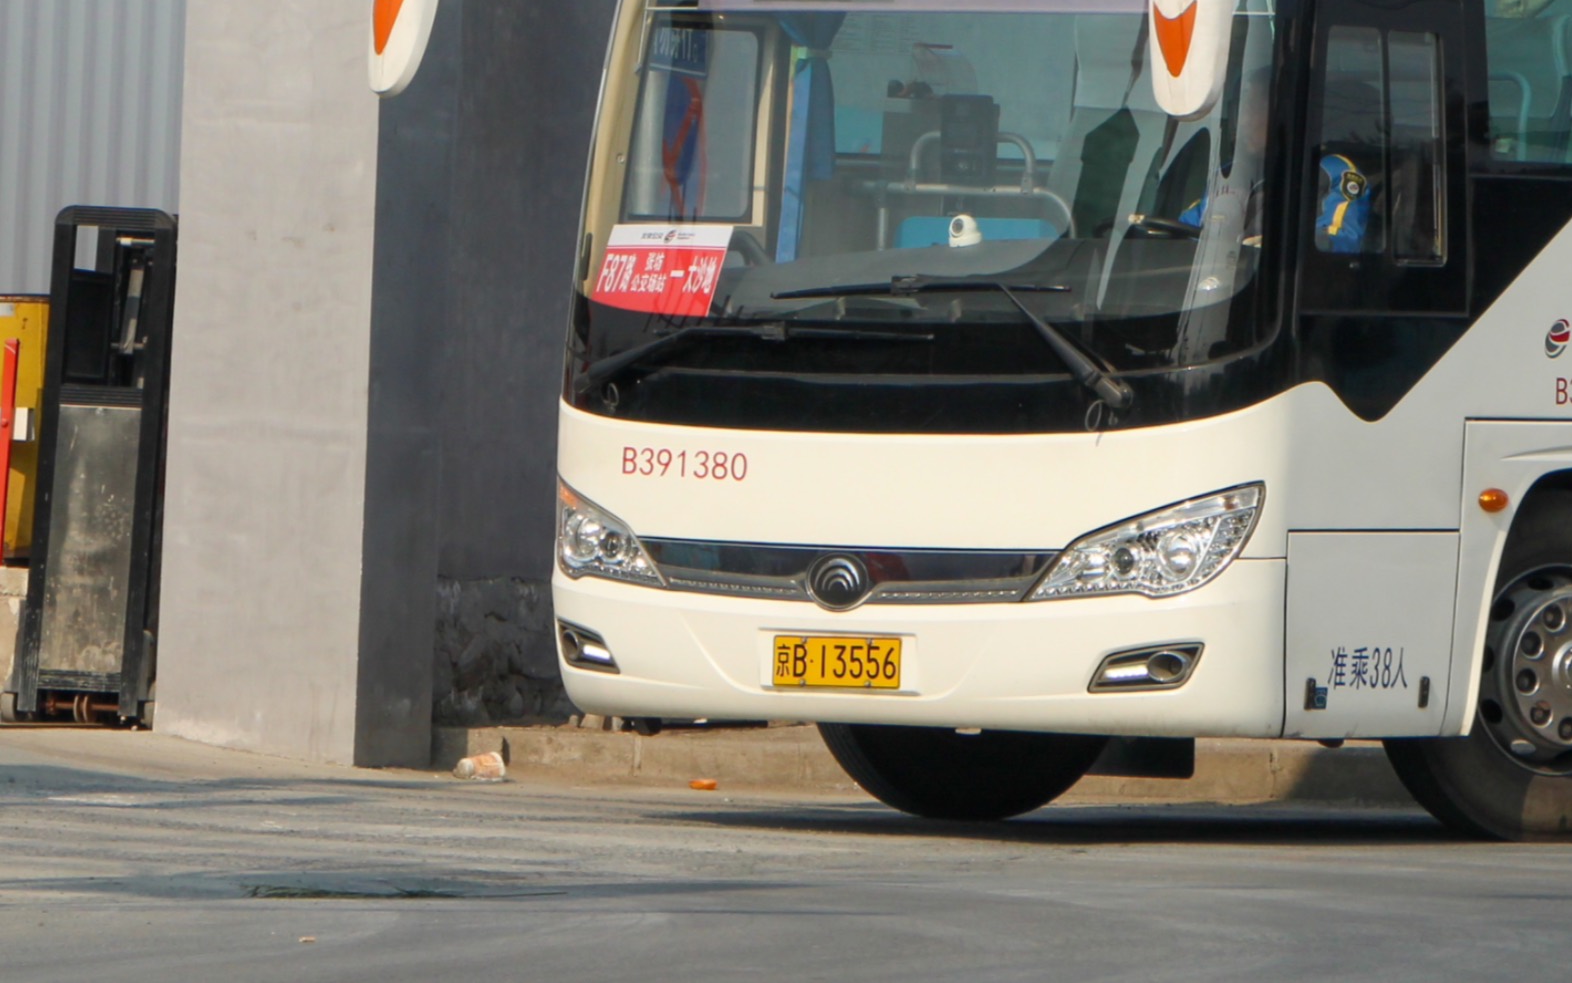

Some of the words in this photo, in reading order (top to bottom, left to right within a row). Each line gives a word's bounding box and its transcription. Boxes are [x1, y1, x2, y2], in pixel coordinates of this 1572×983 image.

[622, 446, 748, 481] B391380
[1327, 647, 1408, 690] 准乘38人
